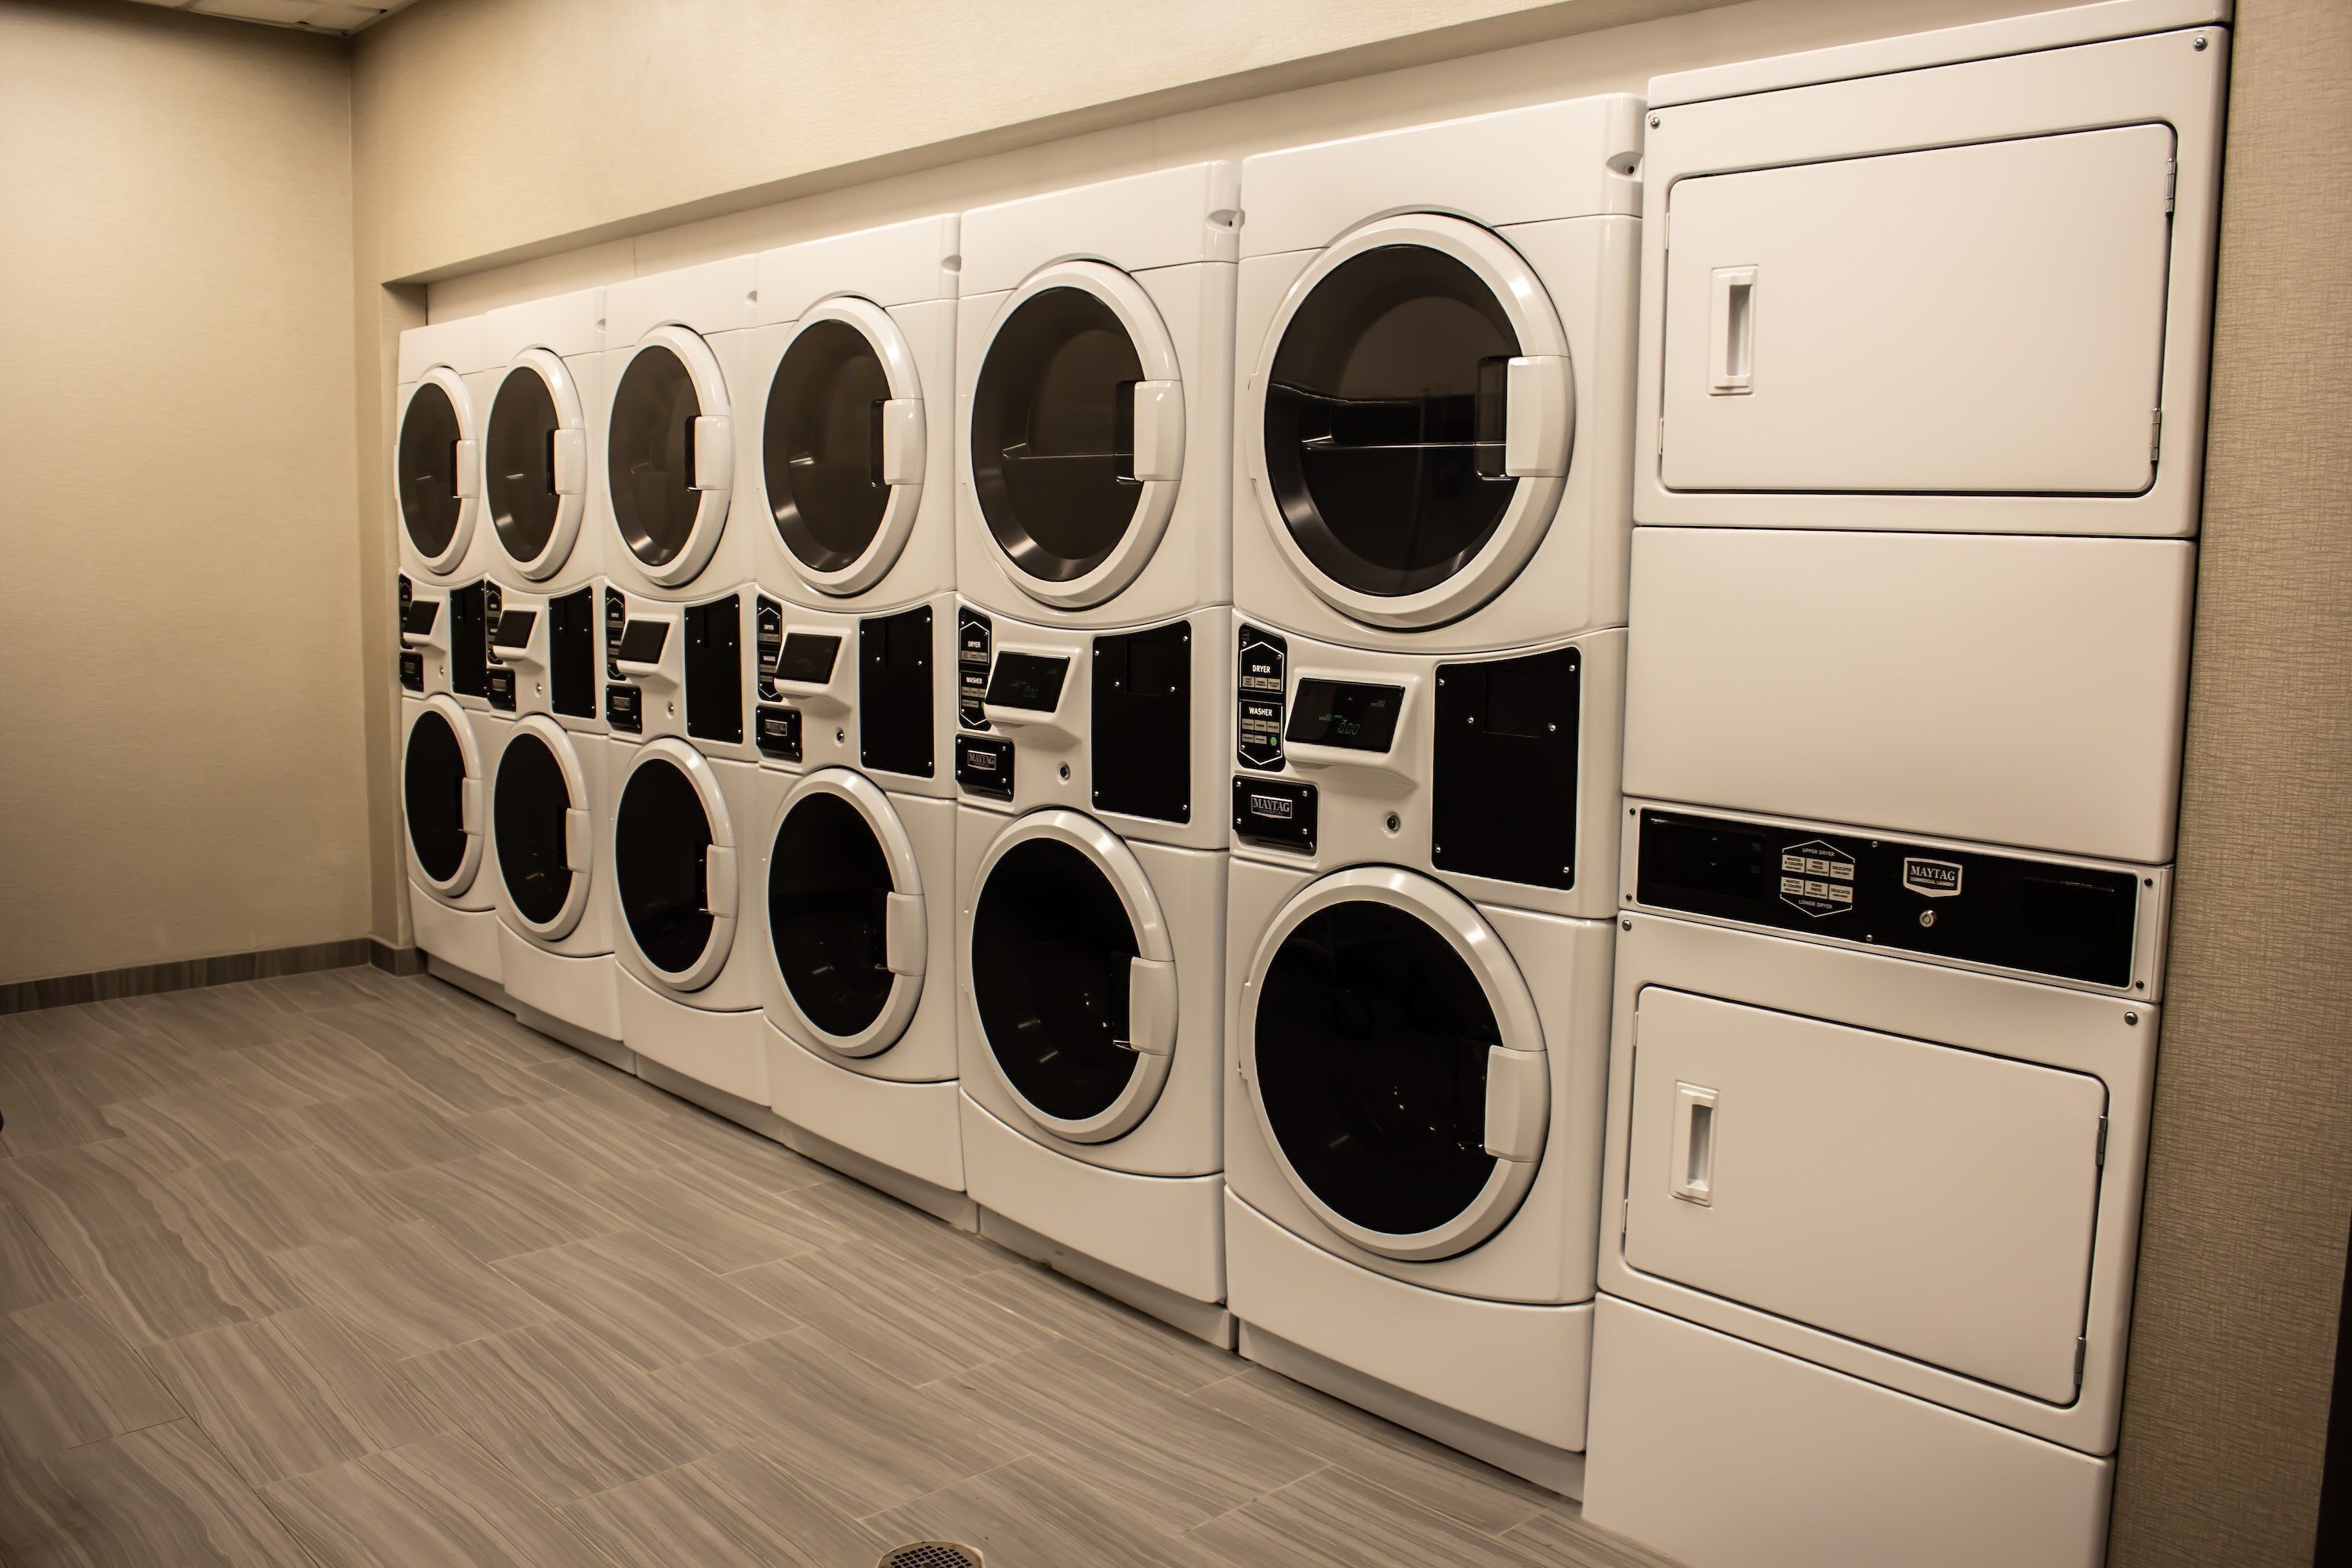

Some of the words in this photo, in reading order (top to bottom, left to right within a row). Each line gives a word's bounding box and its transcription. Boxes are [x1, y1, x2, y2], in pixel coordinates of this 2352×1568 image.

[1252, 664, 1271, 673] DRYER
[1248, 706, 1272, 717] WASHER
[1253, 797, 1290, 812] MAYTAG
[1911, 865, 1955, 881] MAYTAG
